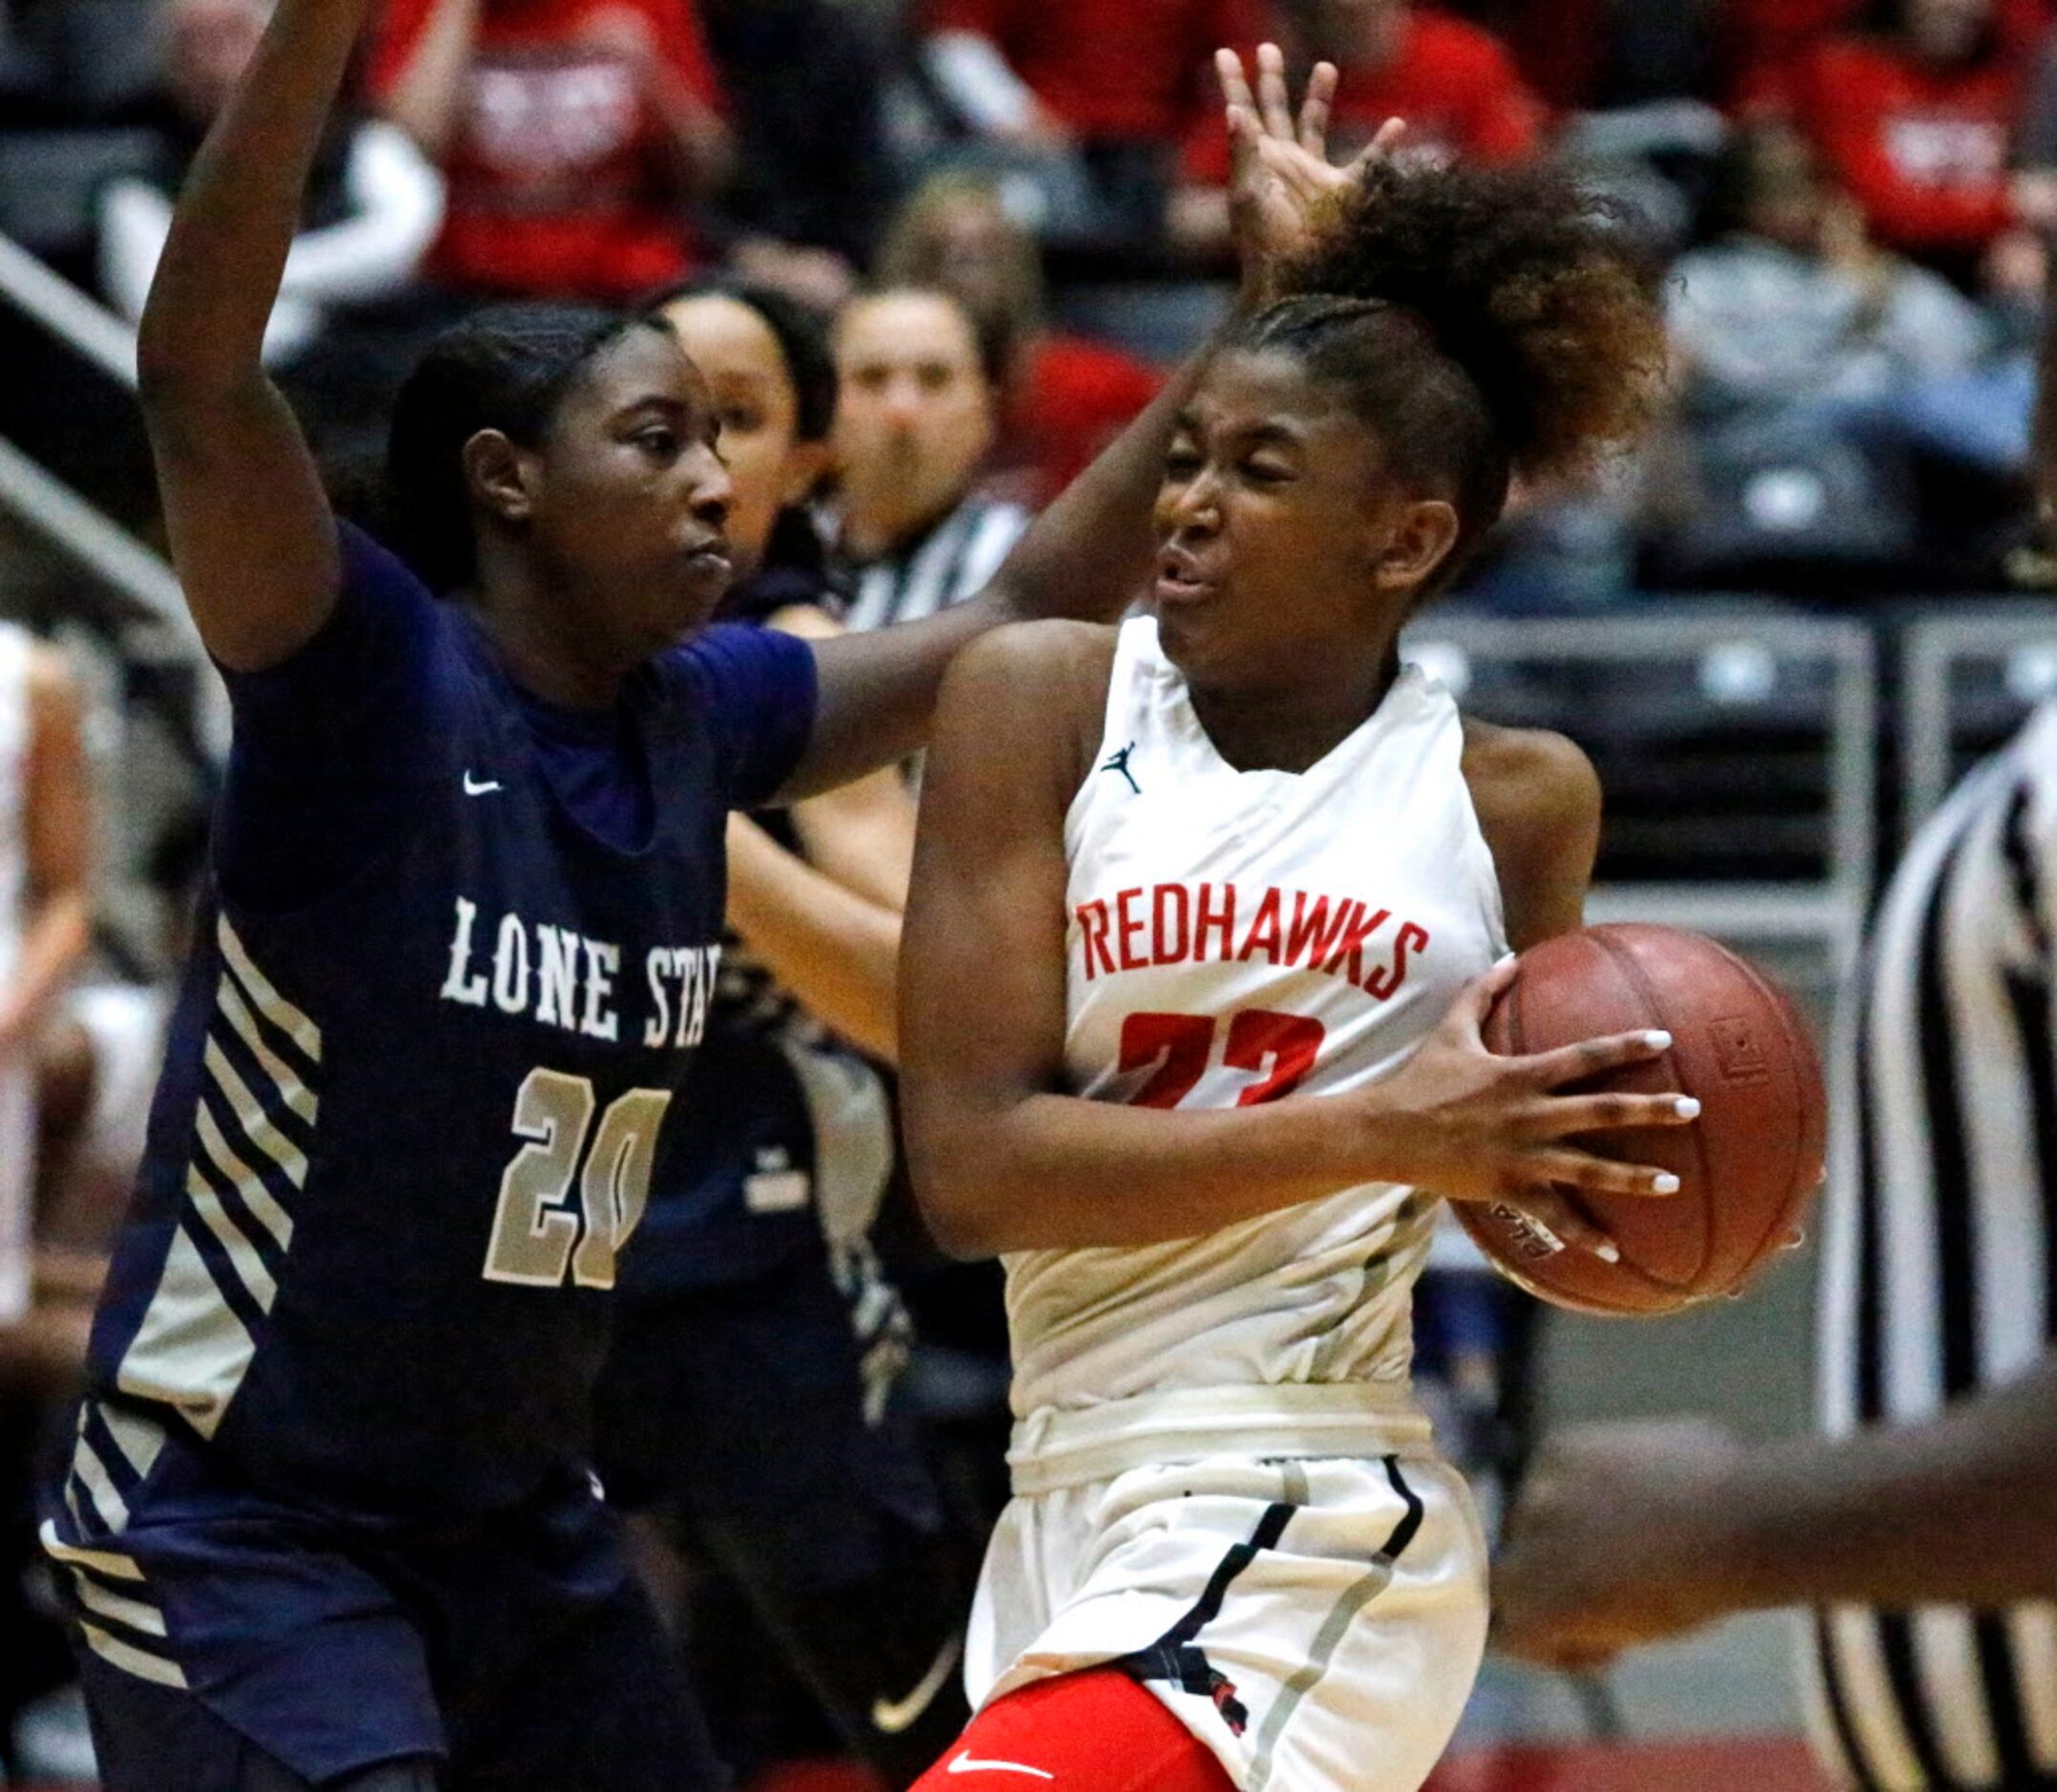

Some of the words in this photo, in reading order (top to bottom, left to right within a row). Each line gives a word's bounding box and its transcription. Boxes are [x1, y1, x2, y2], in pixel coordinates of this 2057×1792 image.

[440, 895, 620, 1042] LONE
[1075, 883, 1429, 1002] REDHAWKS
[482, 1065, 673, 1291] 20
